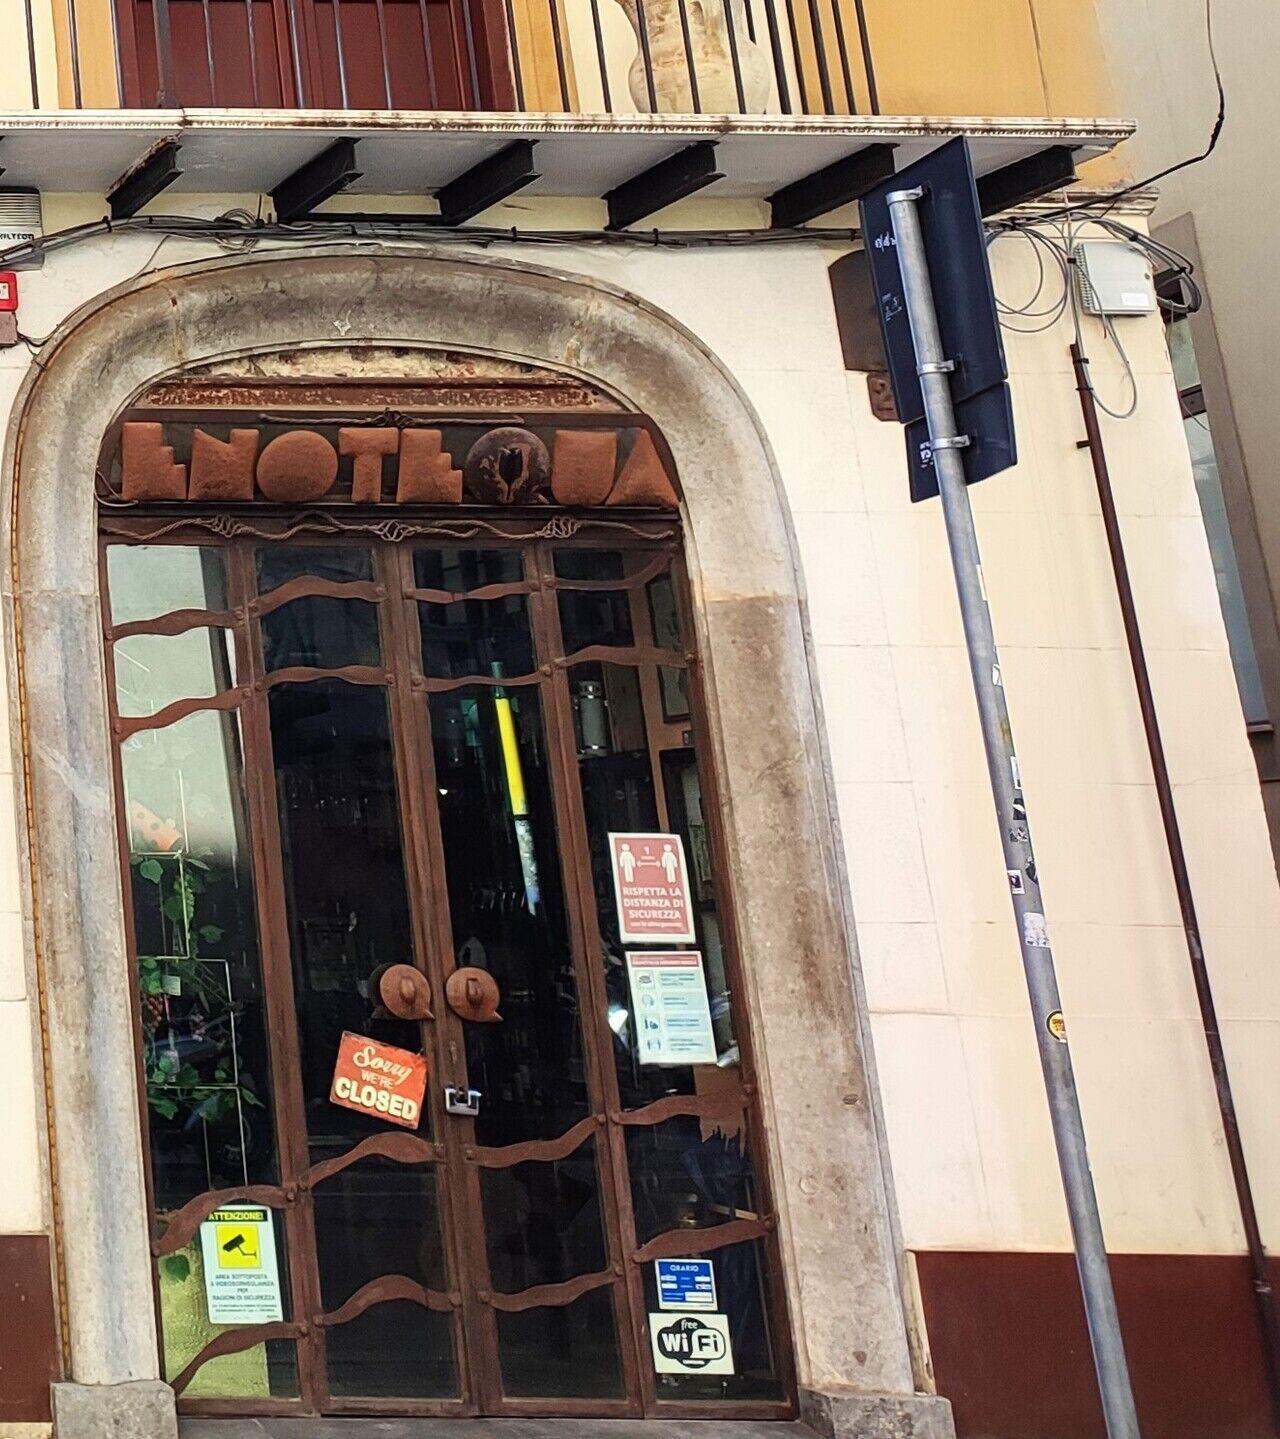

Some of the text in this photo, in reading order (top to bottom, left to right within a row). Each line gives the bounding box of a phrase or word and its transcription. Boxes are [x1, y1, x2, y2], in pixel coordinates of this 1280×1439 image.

[622, 887, 682, 897] RISPETTA LA
[623, 898, 684, 908] DISTANZA DI
[629, 909, 682, 919] SICUREZZA
[353, 1045, 413, 1086] Sorry
[361, 1068, 396, 1089] WE'RE
[335, 1076, 418, 1120] CLOSED
[680, 1319, 699, 1330] free
